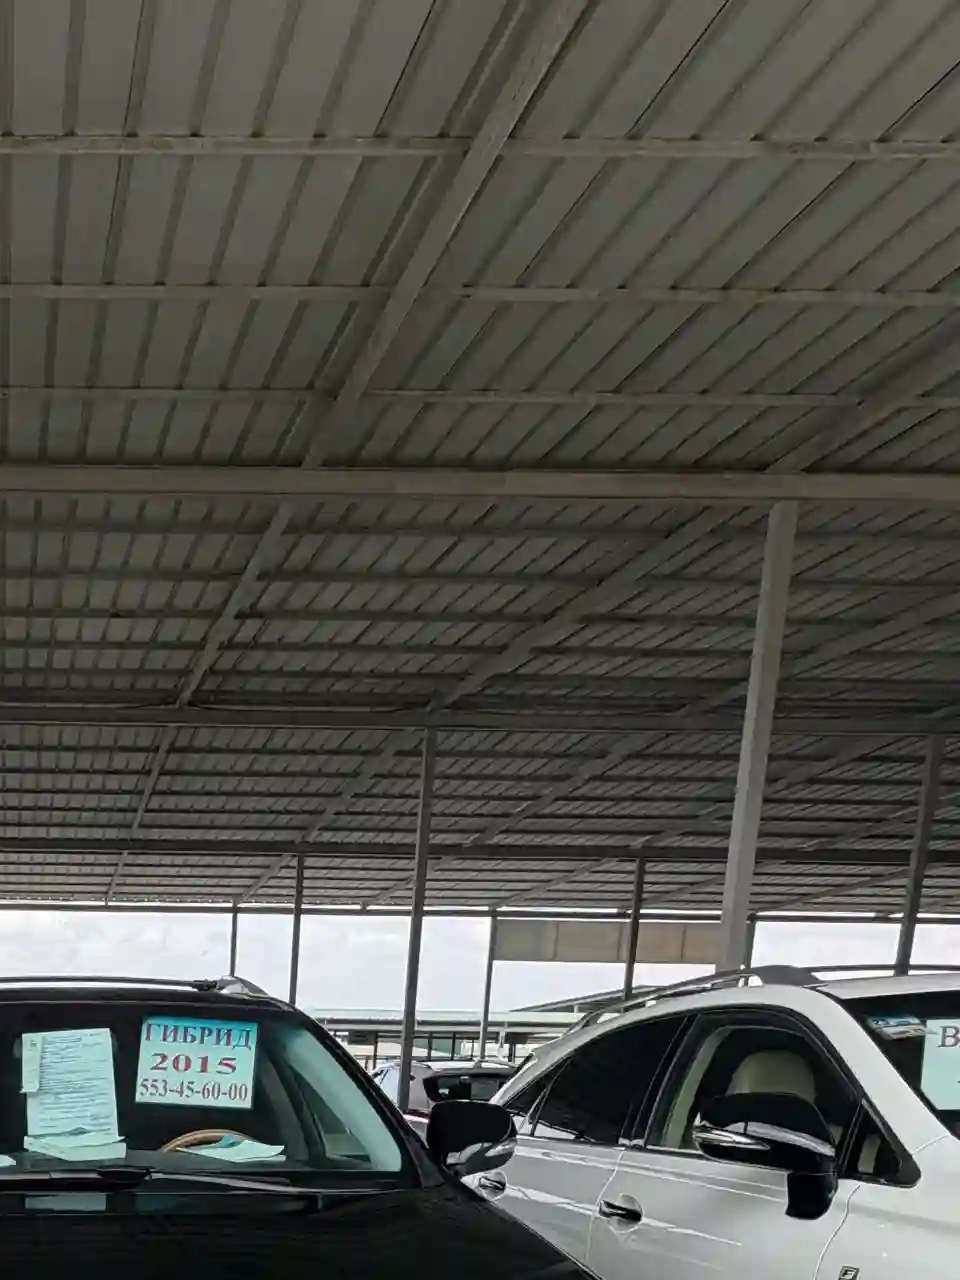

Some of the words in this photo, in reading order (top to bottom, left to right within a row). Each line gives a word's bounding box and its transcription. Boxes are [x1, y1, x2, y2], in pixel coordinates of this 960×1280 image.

[145, 1022, 252, 1051] ГИБРИД
[149, 1052, 237, 1075] 2015
[140, 1078, 248, 1101] 553-45-60-00
